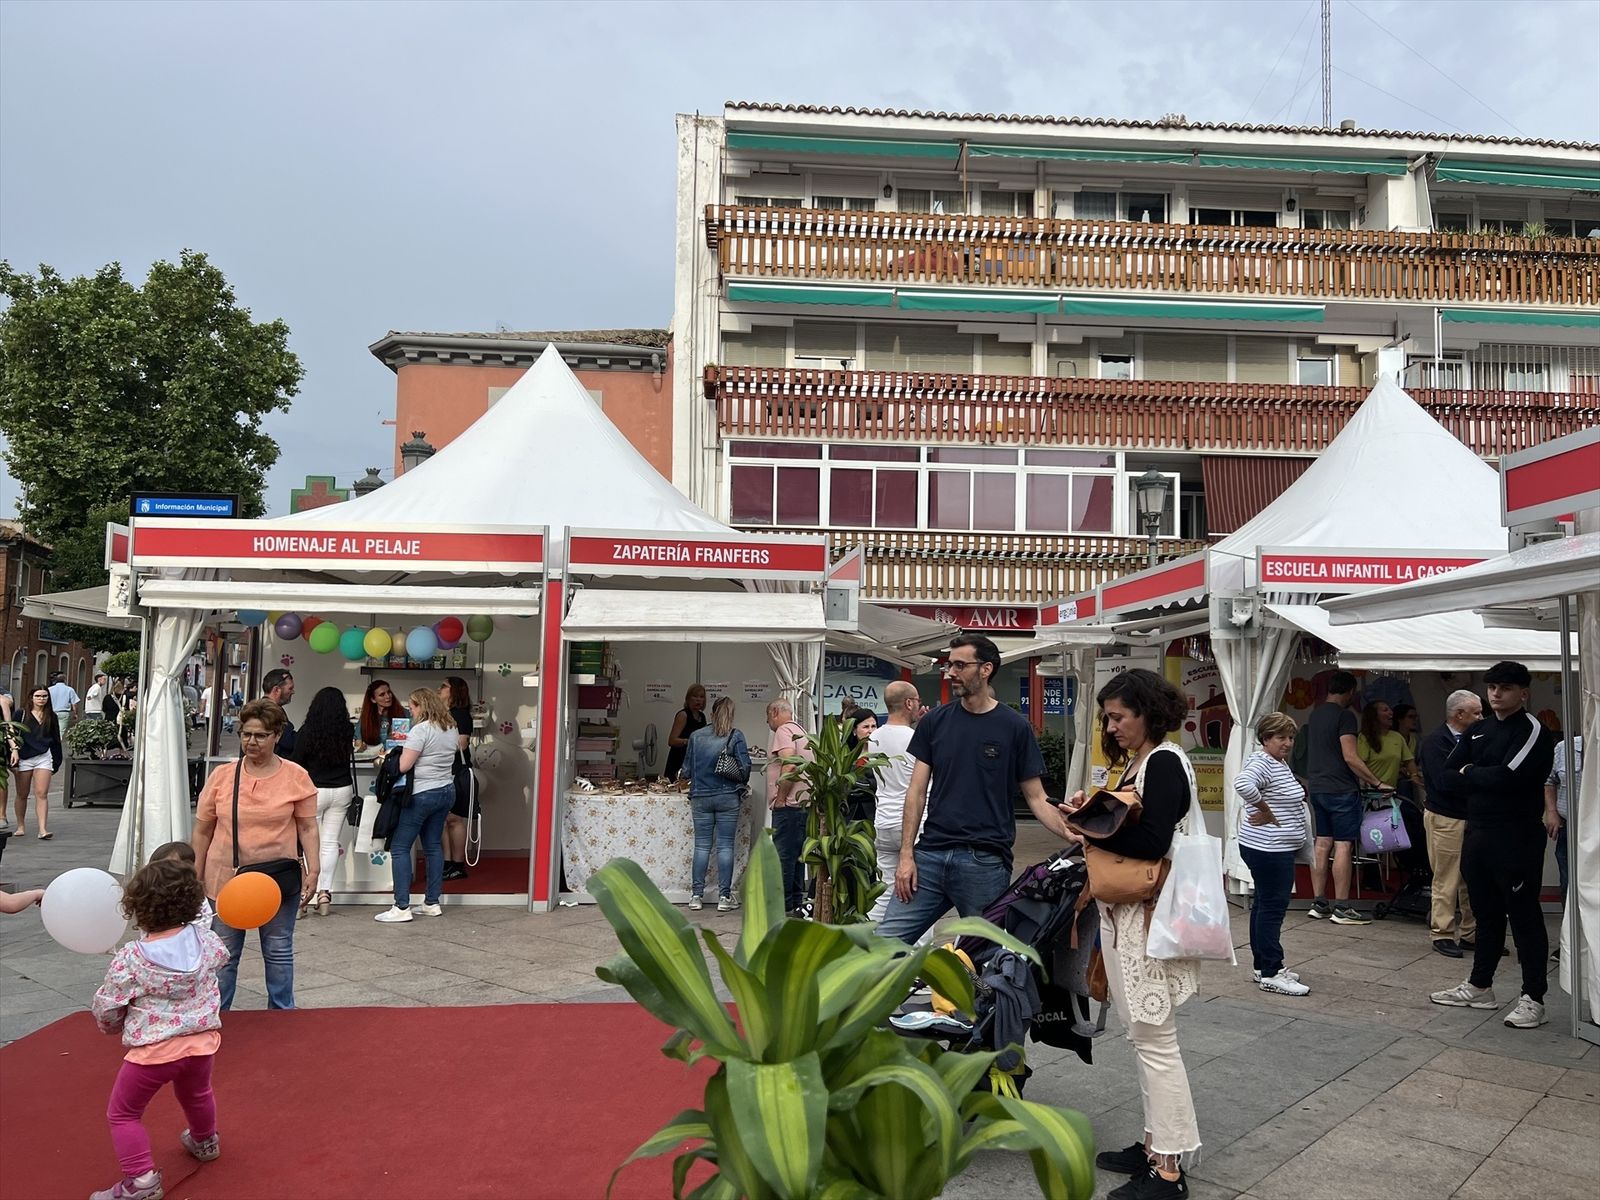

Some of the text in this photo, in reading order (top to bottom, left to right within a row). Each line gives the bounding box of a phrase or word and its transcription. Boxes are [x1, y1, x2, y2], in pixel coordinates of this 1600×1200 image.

[154, 502, 229, 513] Información Municipal
[253, 536, 421, 555] HOMENAJE AL PELAJE
[612, 543, 770, 564] ZAPATERÍA FRANFERS
[1266, 561, 1328, 578] ESCUELA
[1332, 563, 1392, 579] INFANTIL
[1396, 565, 1414, 579] LA
[968, 608, 1020, 627] AMR
[824, 654, 876, 669] QUILER
[1187, 665, 1218, 676] ESCUEL
[823, 684, 878, 699] CASA
[1043, 689, 1061, 697] NDE
[1050, 697, 1060, 705] 85
[1037, 1011, 1067, 1023] OCAL
